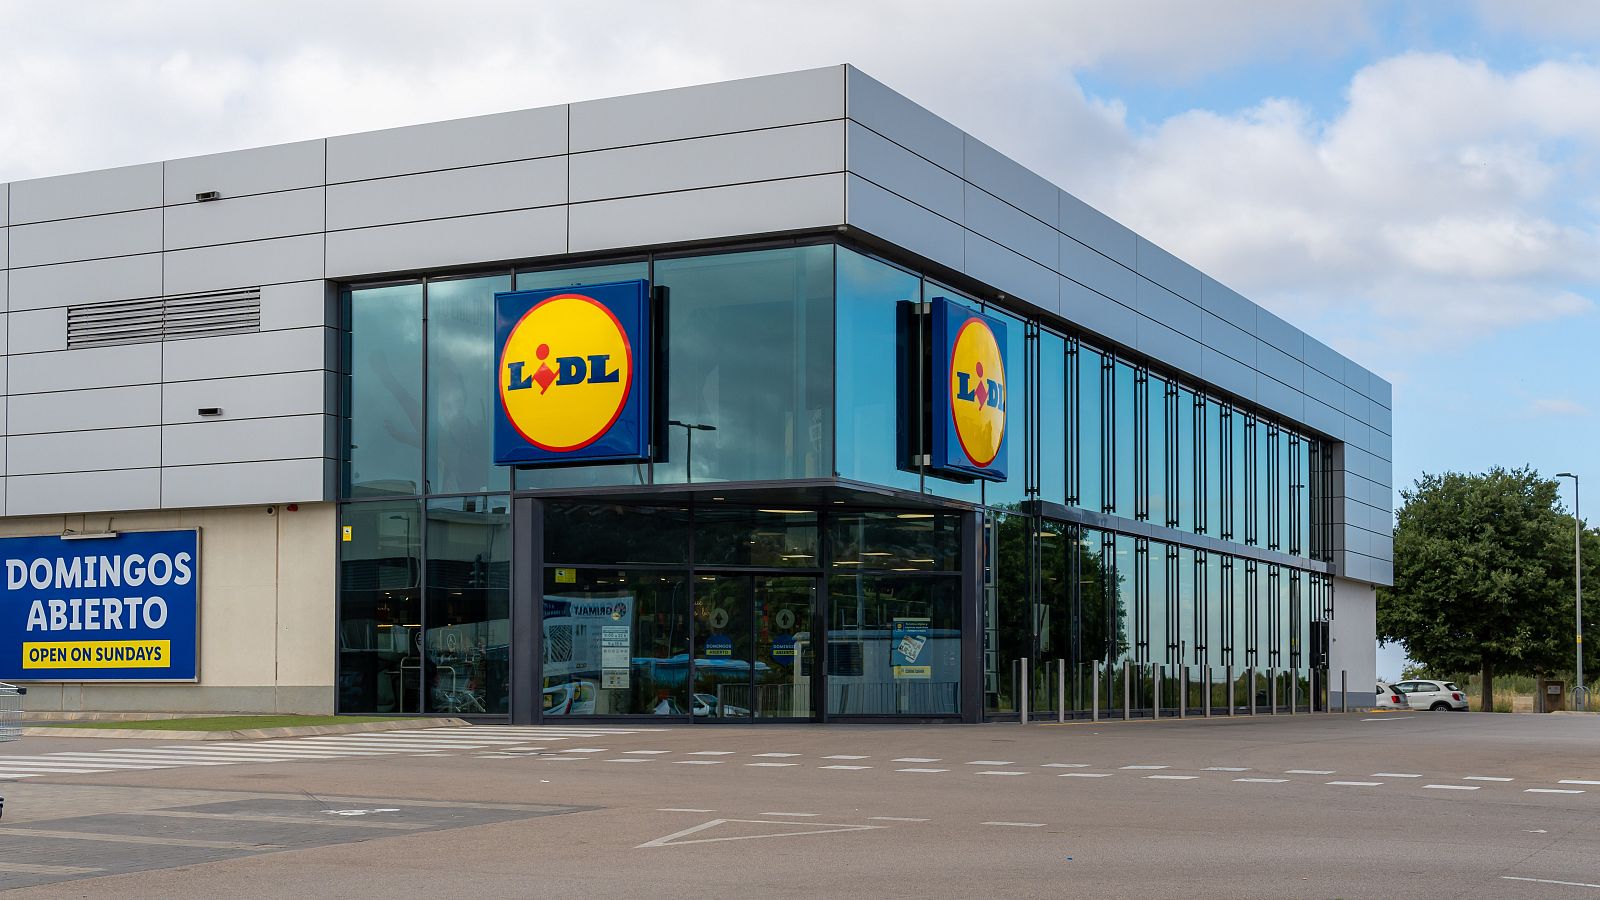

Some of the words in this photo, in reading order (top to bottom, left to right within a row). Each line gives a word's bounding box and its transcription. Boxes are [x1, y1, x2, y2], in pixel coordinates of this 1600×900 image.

[5, 551, 192, 590] DOMINGOS
[26, 596, 168, 631] ABIERTO
[29, 647, 67, 662] OPEN
[70, 647, 92, 662] ON
[95, 646, 162, 661] SUNDAYS
